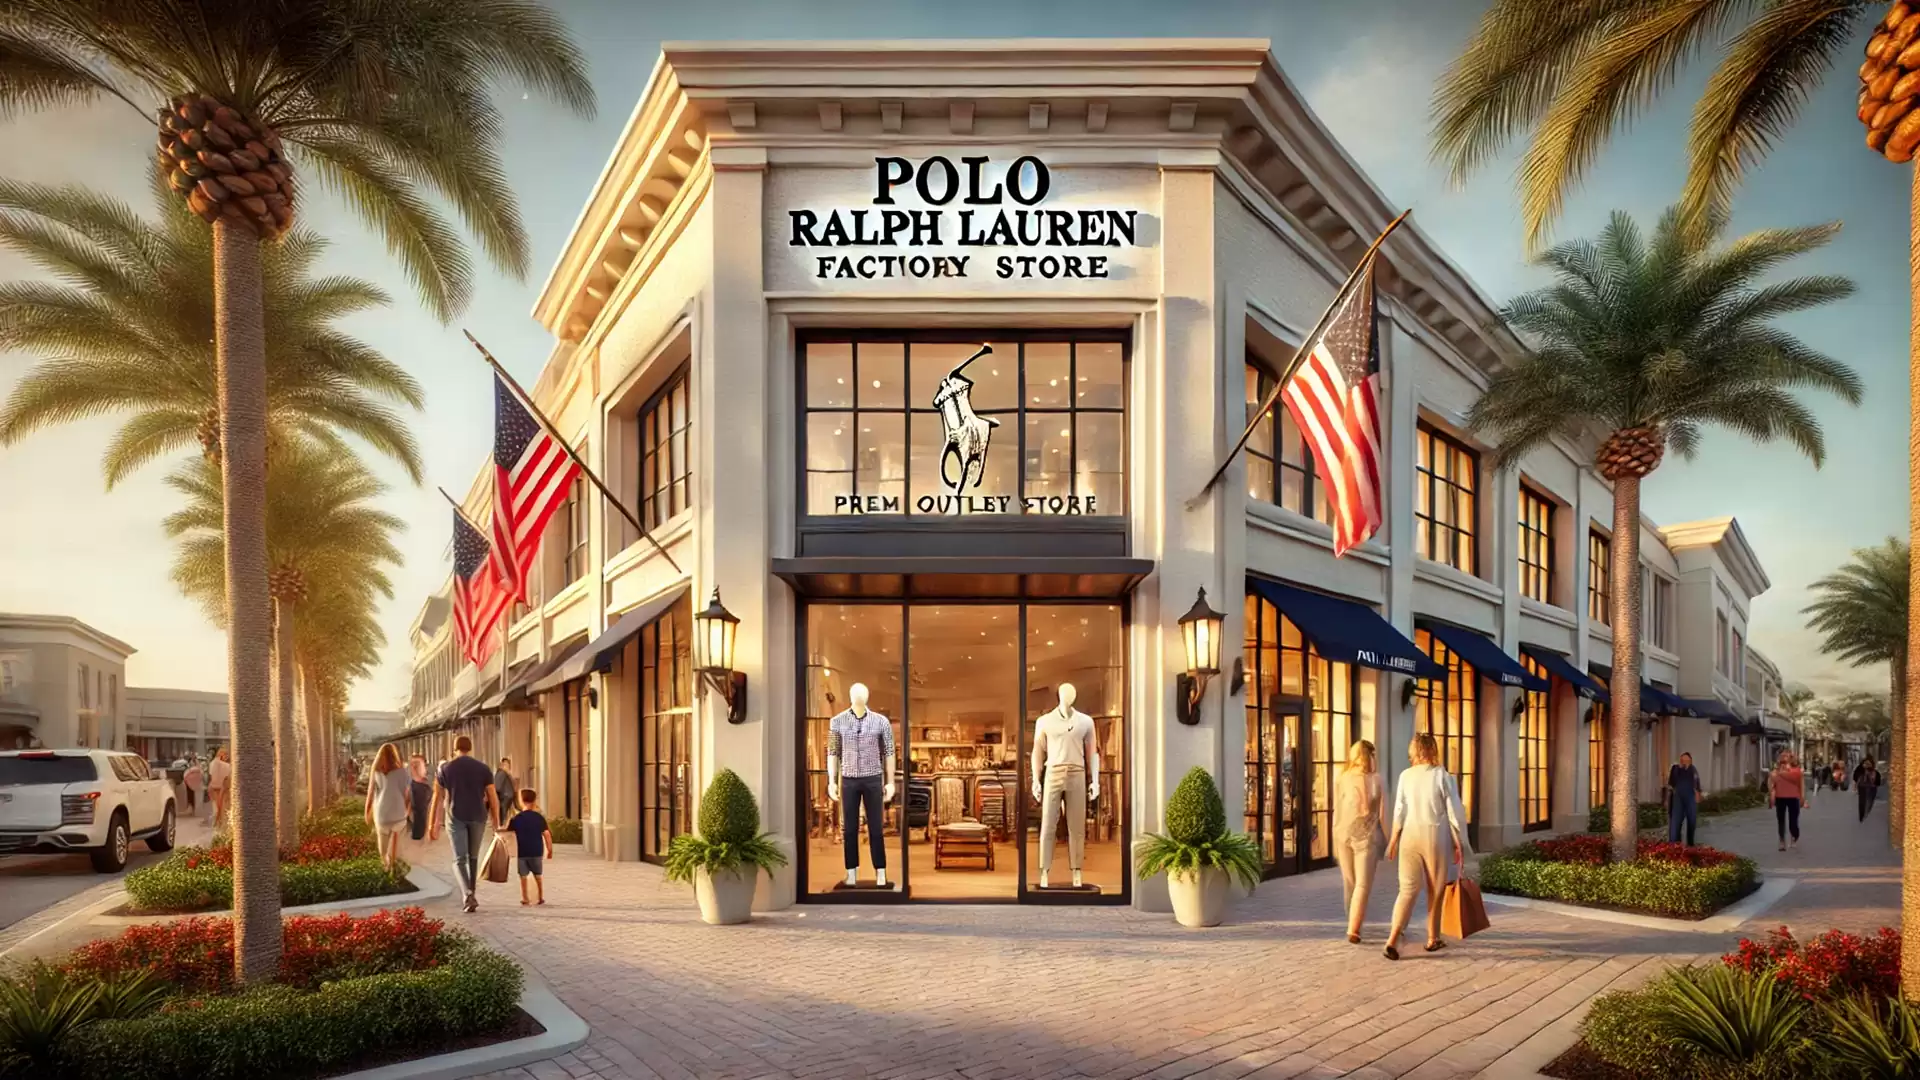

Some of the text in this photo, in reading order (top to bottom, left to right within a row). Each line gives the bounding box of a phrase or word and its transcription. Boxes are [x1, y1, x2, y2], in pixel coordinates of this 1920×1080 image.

[873, 155, 1050, 206] POLO
[788, 209, 1137, 246] RALPH LAUREN
[996, 255, 1108, 278] STORE
